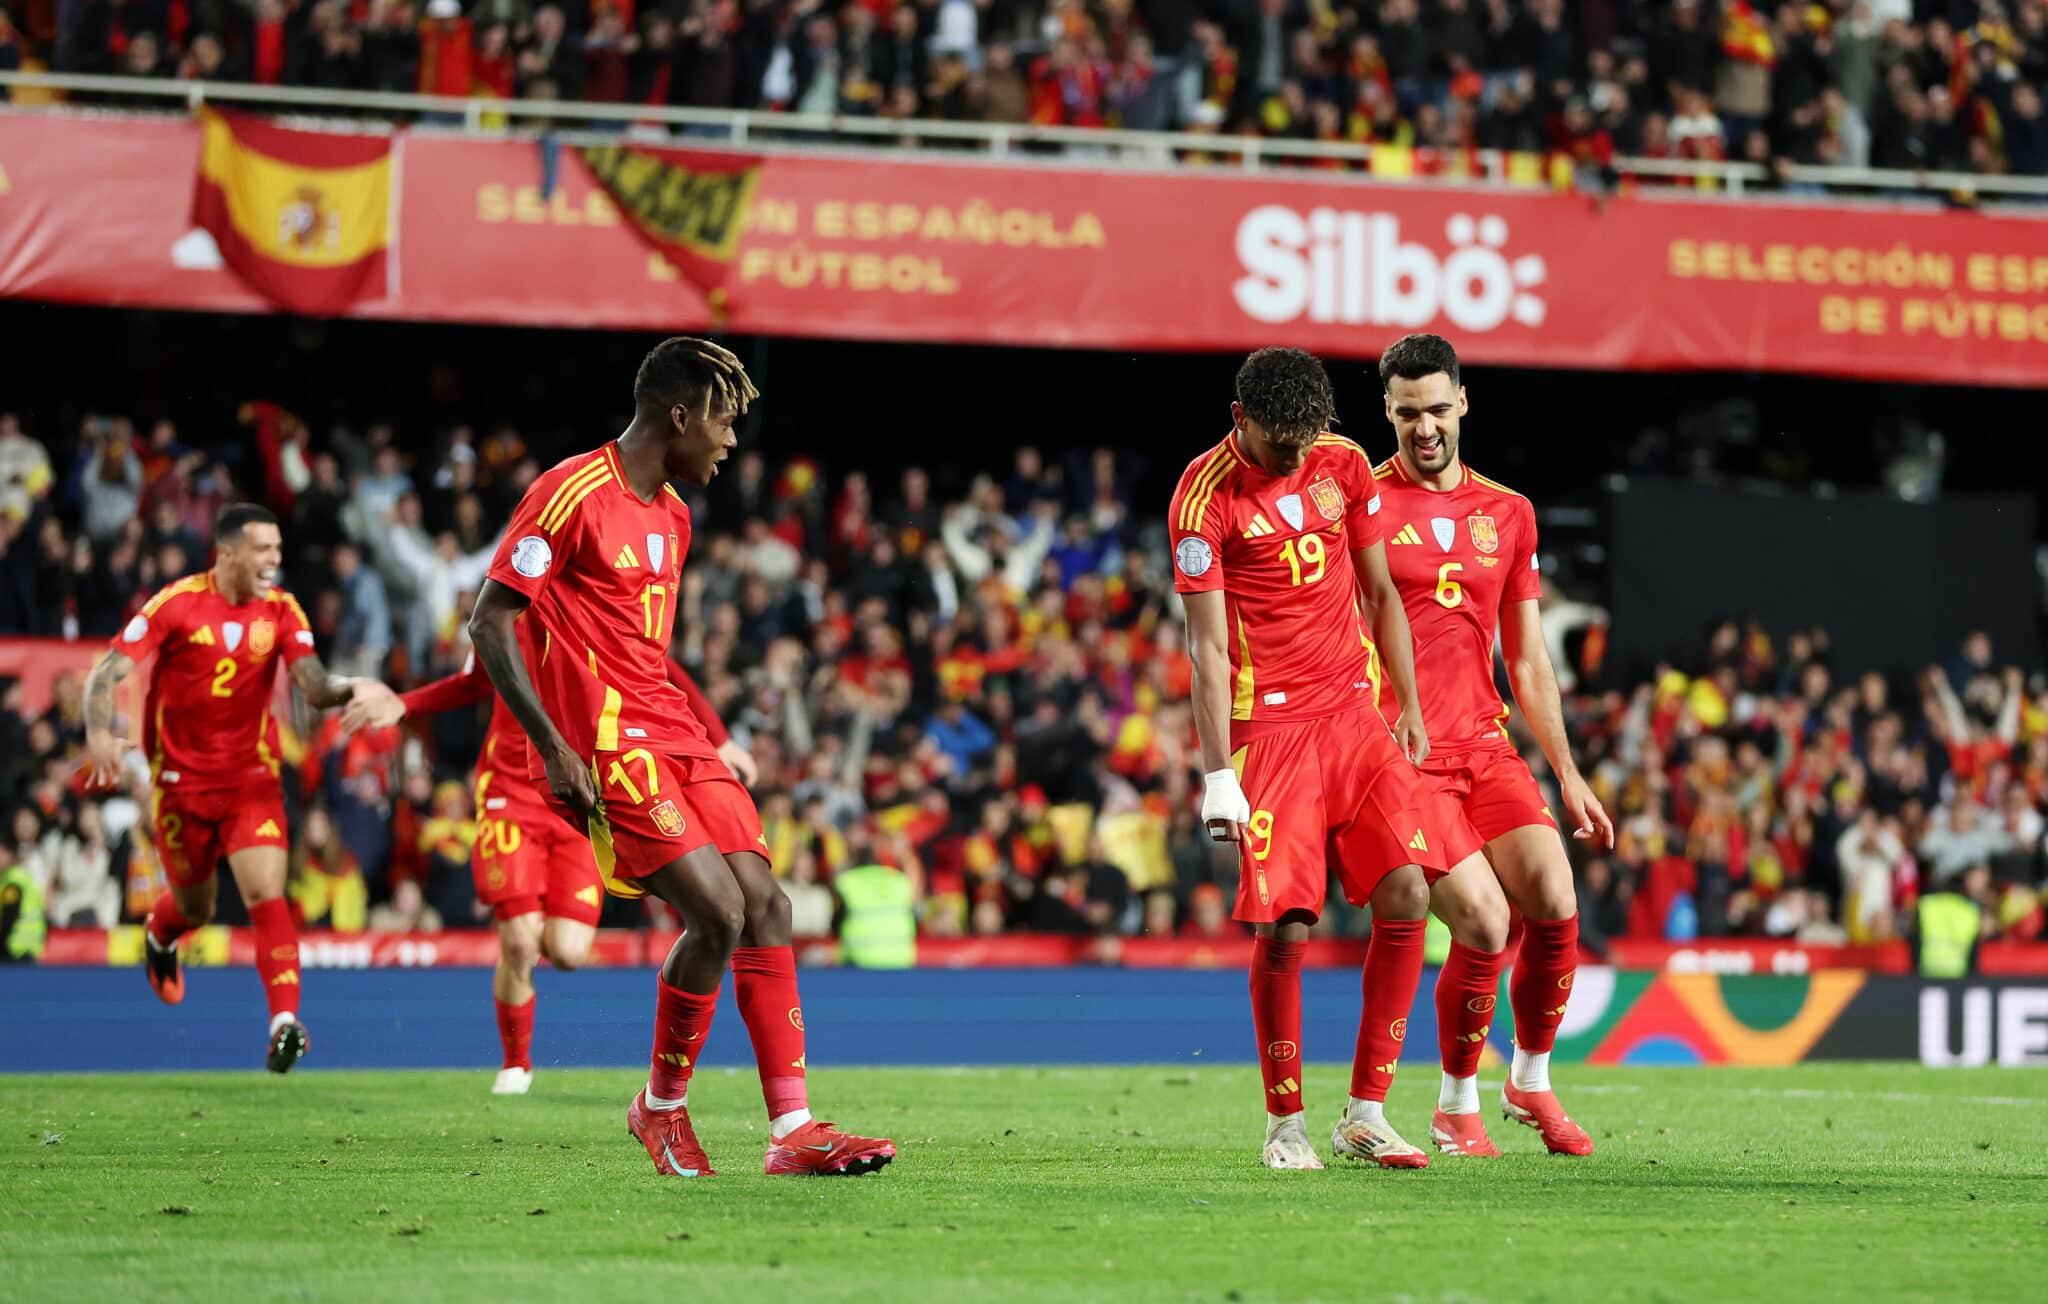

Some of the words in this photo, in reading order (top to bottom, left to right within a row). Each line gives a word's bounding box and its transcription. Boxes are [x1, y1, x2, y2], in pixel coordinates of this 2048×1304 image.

[814, 198, 1107, 248] ESPAÑOLA
[740, 241, 959, 295] FÚTBOL
[1668, 240, 1954, 288] SELECCIÓN
[1820, 295, 1887, 335] DE
[1279, 533, 1326, 586] 19
[1435, 562, 1463, 609] 6
[640, 583, 665, 639] 17
[211, 657, 237, 697] 2
[607, 748, 659, 805] 17
[161, 814, 183, 849] 2
[479, 818, 521, 860] 20
[1246, 809, 1274, 861] 9
